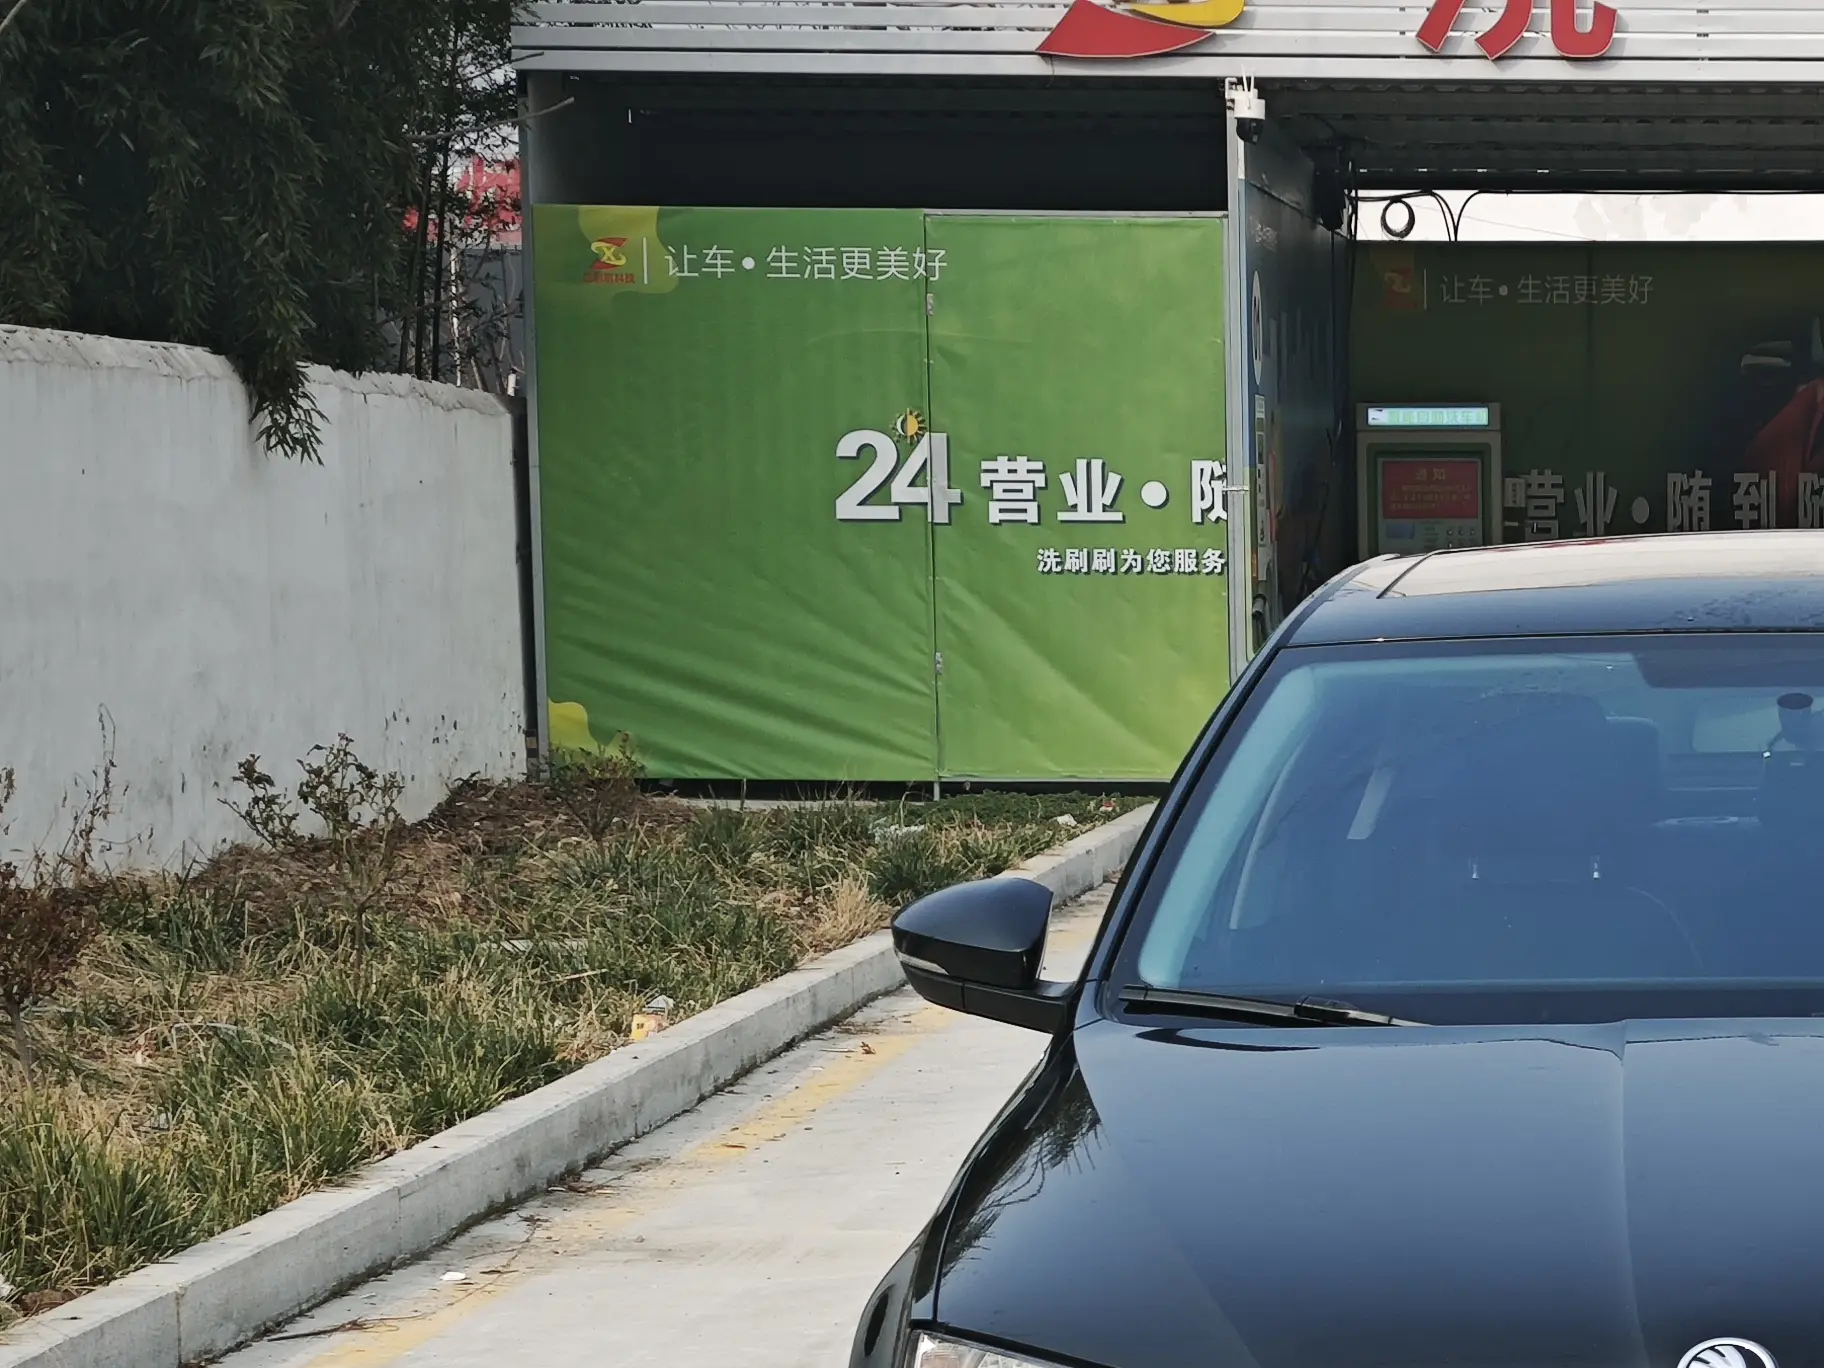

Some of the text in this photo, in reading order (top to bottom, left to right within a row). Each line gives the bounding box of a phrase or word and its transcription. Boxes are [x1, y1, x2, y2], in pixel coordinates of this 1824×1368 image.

[835, 430, 962, 524] 24
[1036, 547, 1227, 575] 洗刷刷为您服务
